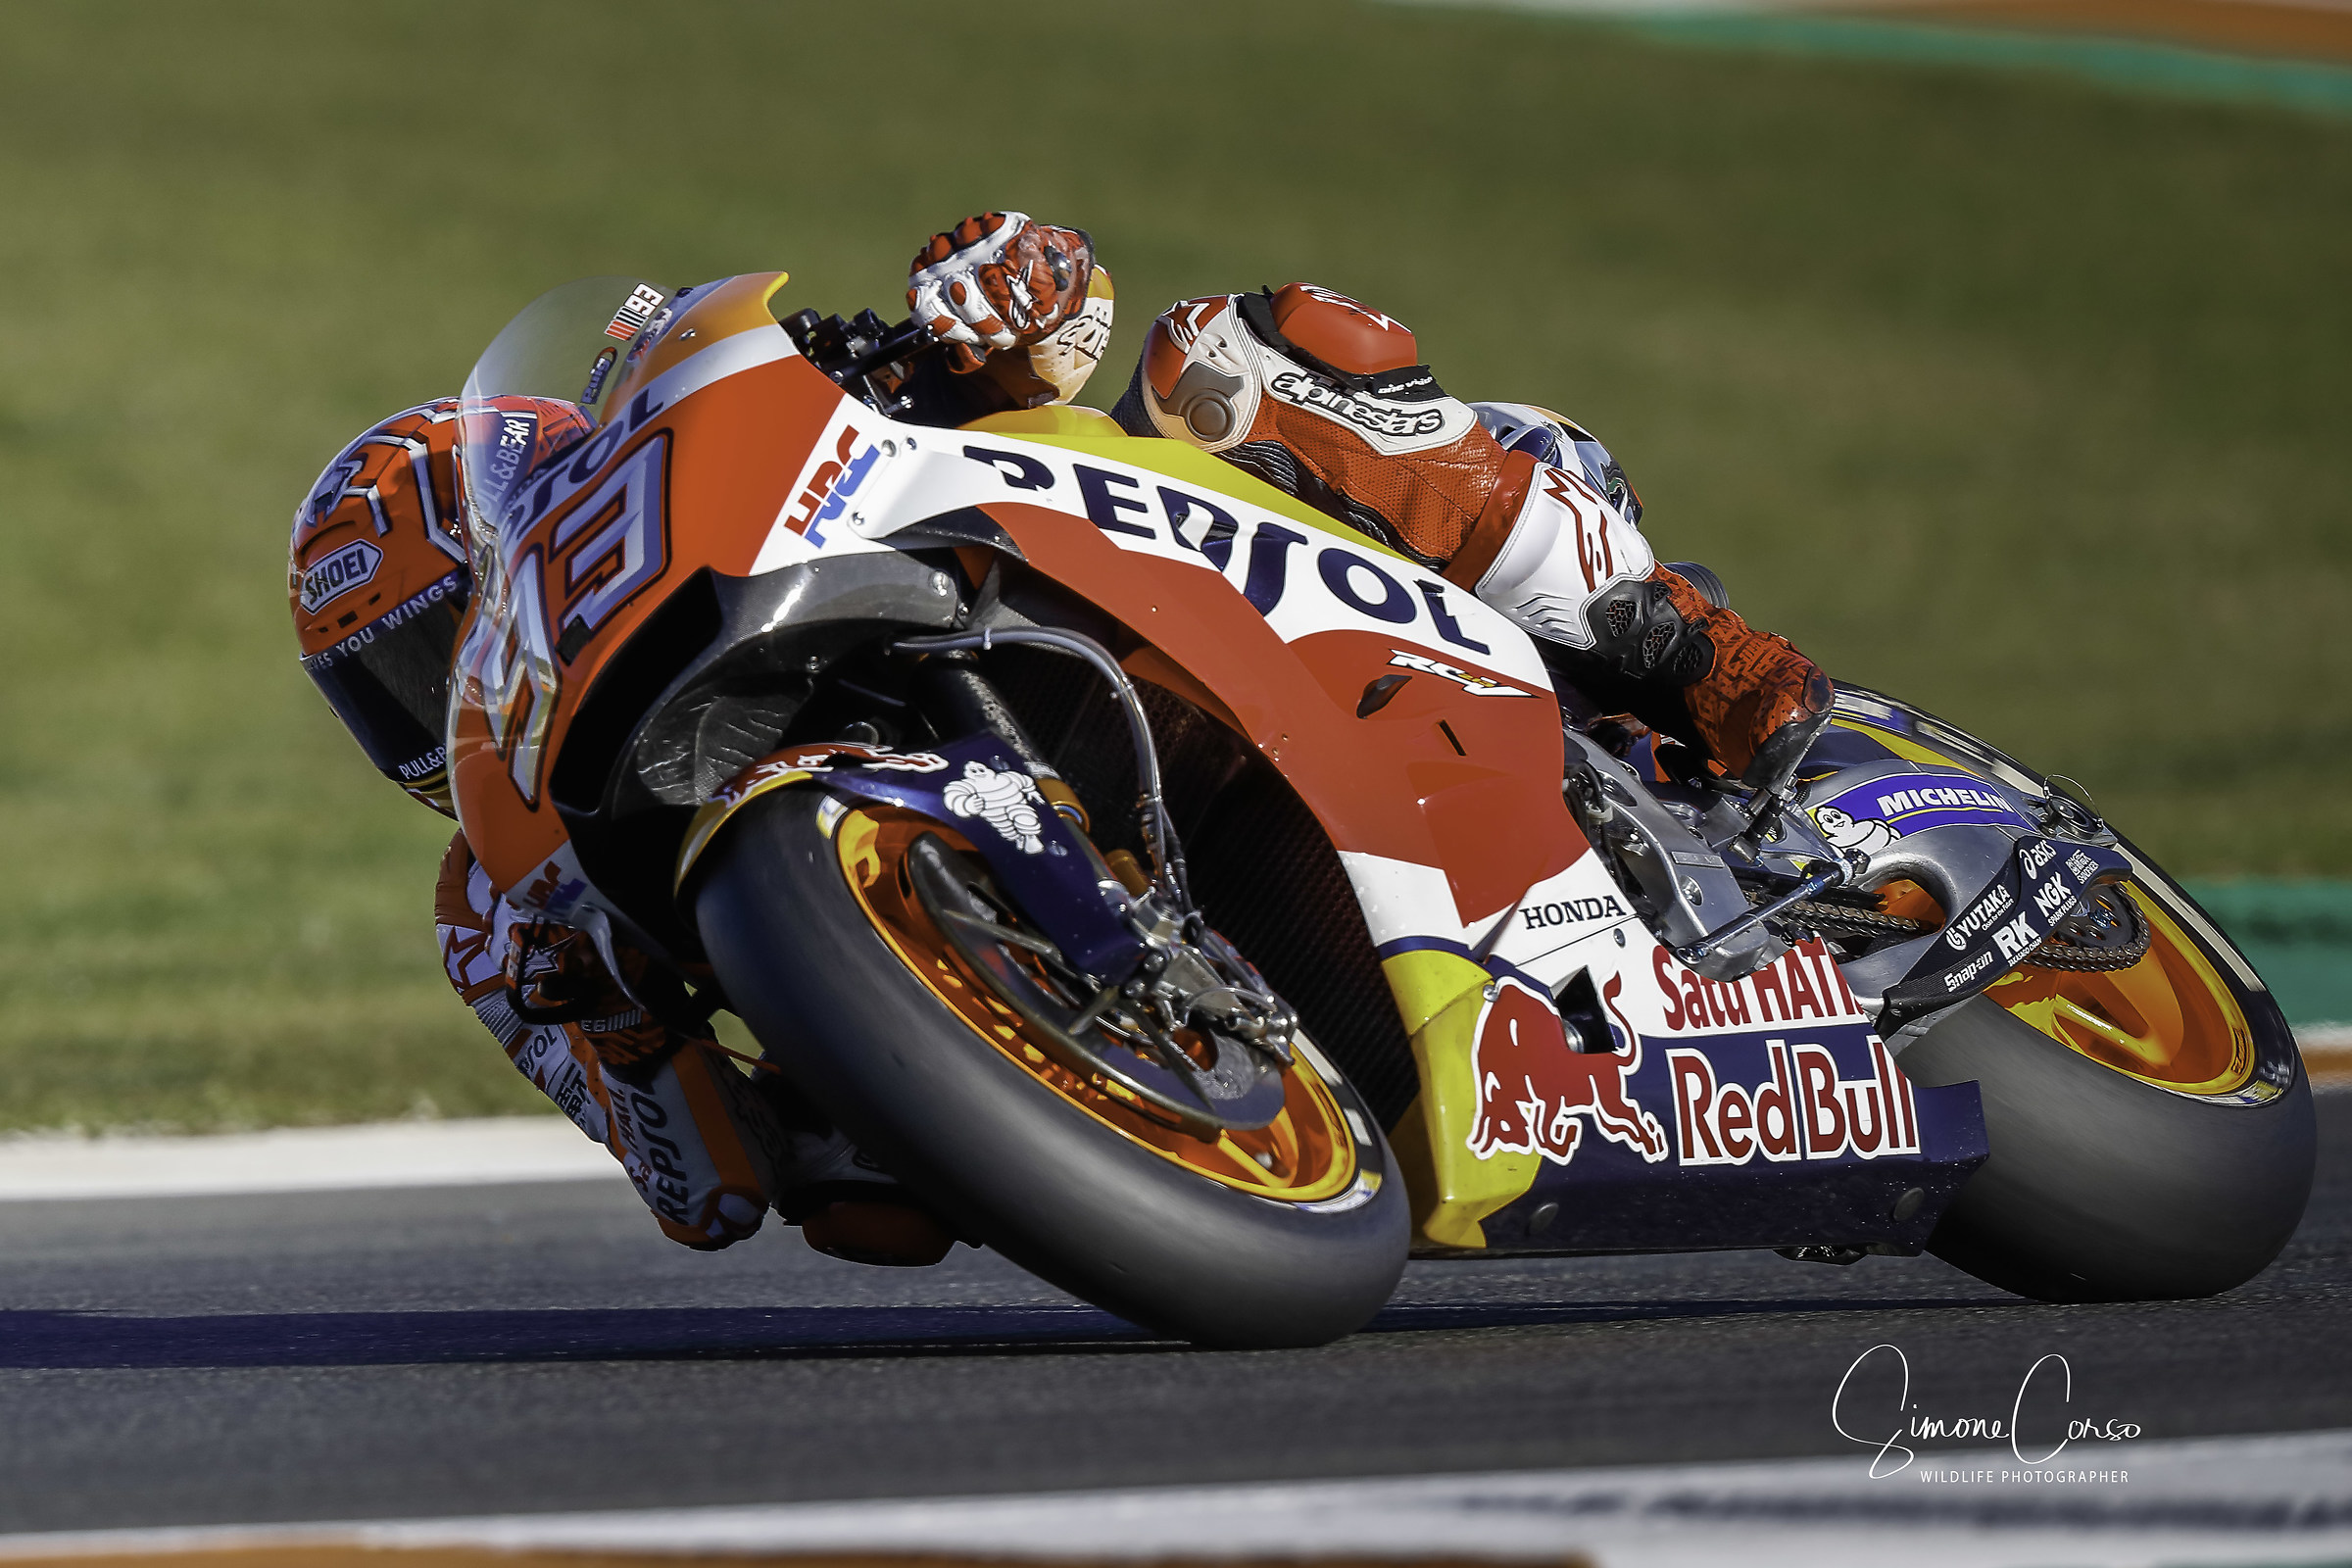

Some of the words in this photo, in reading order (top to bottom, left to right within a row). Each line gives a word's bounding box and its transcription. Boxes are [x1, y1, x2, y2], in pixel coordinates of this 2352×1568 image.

[622, 282, 665, 317] 93
[1273, 372, 1443, 435] alpinestars
[305, 548, 368, 601] SHOEI
[335, 626, 374, 658] YOU
[382, 576, 459, 630] WINGS
[1878, 787, 2014, 817] MICHELIN
[1523, 895, 1627, 930] HONDA
[1957, 884, 2011, 938] YUTAKA
[2033, 871, 2072, 918] NGK
[1991, 910, 2040, 960] RK
